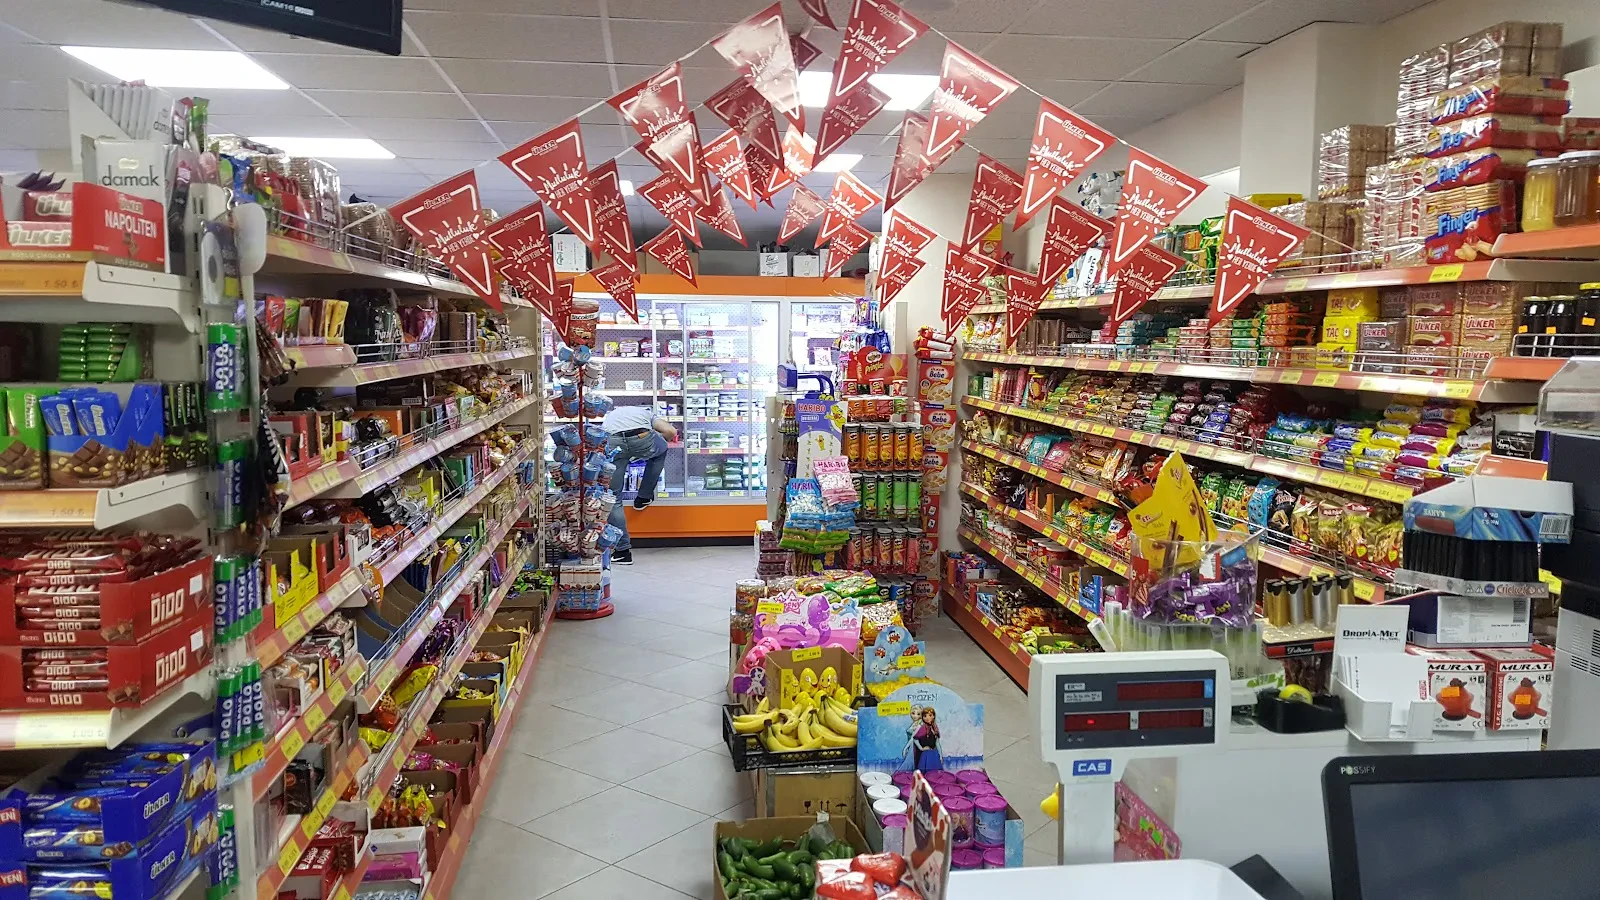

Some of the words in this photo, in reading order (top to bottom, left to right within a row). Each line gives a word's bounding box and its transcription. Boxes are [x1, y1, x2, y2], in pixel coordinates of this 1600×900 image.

[854, 28, 887, 57] Mutluluk
[648, 112, 683, 138] Mutluluk
[1062, 119, 1086, 138] ÜLKER
[532, 140, 557, 155] ÜLKER
[1039, 144, 1076, 171] Mutluluk
[102, 165, 160, 186] damak
[542, 168, 582, 194] Mutluluk
[1152, 166, 1177, 185] ÜLKER
[1438, 158, 1469, 184] Finger
[424, 194, 450, 209] ÜLKER
[979, 190, 1006, 211] Mutluluk
[1128, 192, 1167, 219] Mutluluk
[1253, 216, 1278, 234] ÜLKER
[1438, 207, 1478, 237] Finger
[435, 221, 478, 249] Mutluluk
[1052, 230, 1080, 252] Mutluluk
[513, 239, 544, 260] Mutluluk
[1231, 242, 1268, 268] Mutluluk
[1125, 267, 1155, 288] Mutluluk
[1416, 290, 1440, 300] ÜLKER
[1470, 284, 1498, 295] ÜLKER
[1326, 326, 1339, 340] TAÇ
[1364, 326, 1387, 338] ÜLKER
[1415, 321, 1442, 332] ÜLKER
[1466, 318, 1495, 330] ÜLKER
[930, 371, 945, 379] Bebe
[798, 402, 826, 413] HARIBO
[932, 415, 948, 424] Bebe
[818, 460, 846, 468] HARIBO
[924, 458, 940, 466] Bebe
[1497, 583, 1528, 595] Cricket
[215, 584, 227, 624] POLO
[242, 684, 252, 728] POLO
[252, 682, 262, 724] POLO
[907, 694, 938, 702] FROZEN
[220, 699, 233, 740] POLO
[1078, 762, 1107, 773] CAS
[0, 809, 16, 821] ENİ
[144, 792, 170, 819] ÜLKER
[150, 851, 176, 879] ÜLKER
